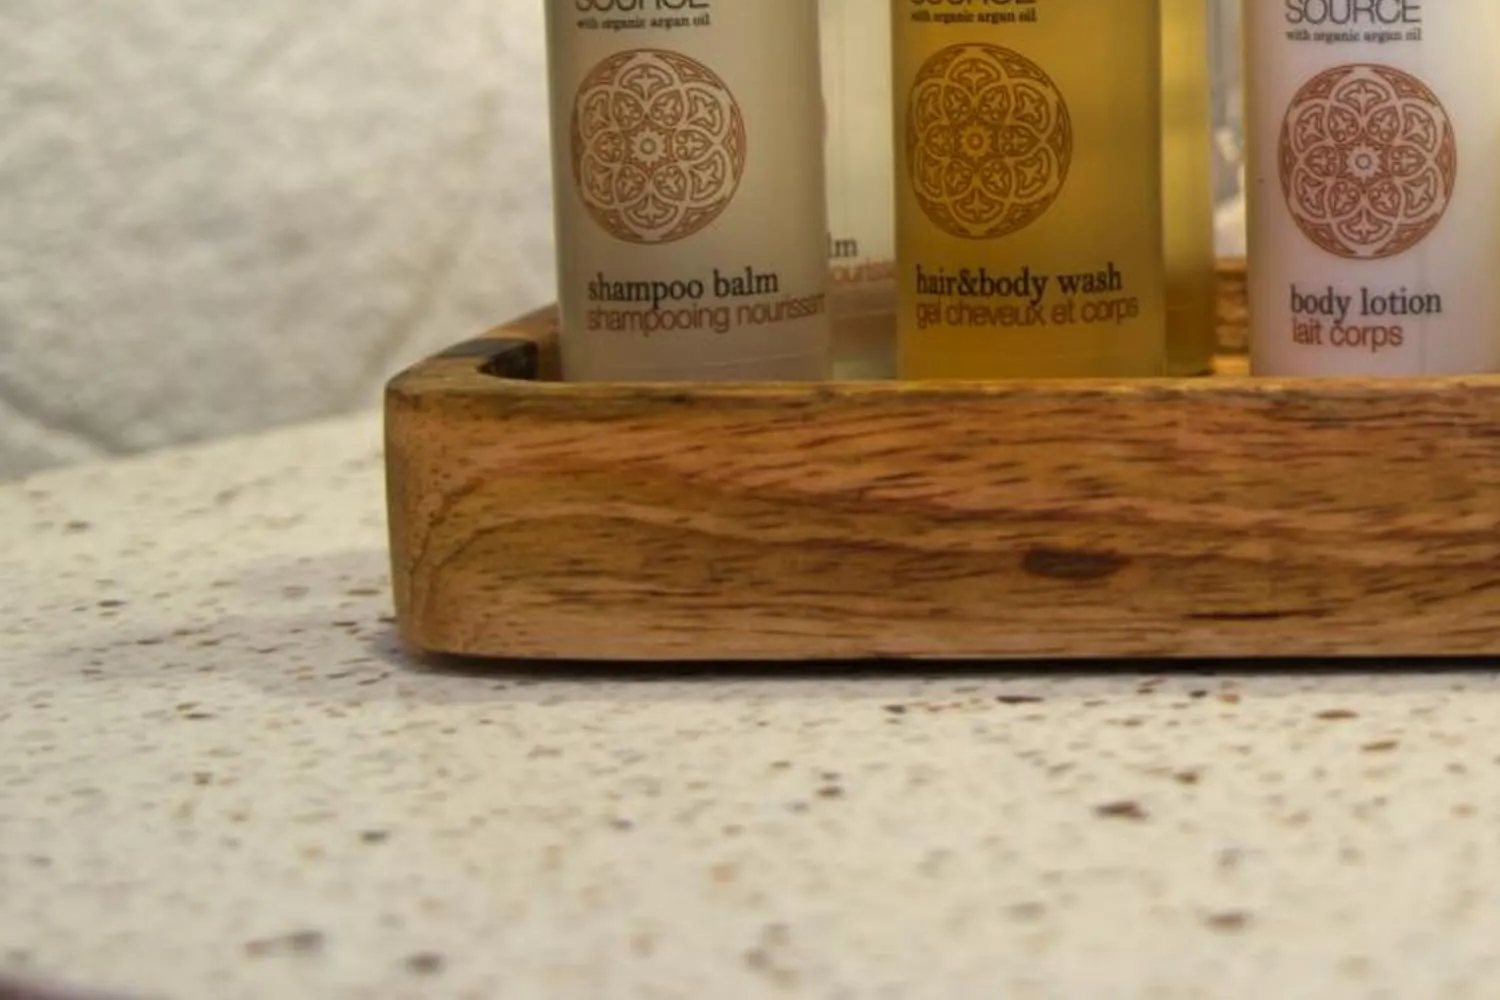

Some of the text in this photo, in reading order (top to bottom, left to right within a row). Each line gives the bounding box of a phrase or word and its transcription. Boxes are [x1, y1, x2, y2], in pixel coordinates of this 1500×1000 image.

[602, 16, 645, 32] organic
[650, 16, 689, 31] argan
[977, 10, 1016, 24] argan
[1019, 8, 1037, 22] oil
[1286, 28, 1311, 41] with
[1313, 28, 1360, 44] organic
[1363, 29, 1402, 44] argan
[588, 266, 779, 309] shampoo balm
[916, 264, 1048, 306] hair&body
[1056, 262, 1122, 294] wash
[588, 303, 729, 337] shampooing
[916, 296, 1139, 329] gel cheveux et corps
[1290, 284, 1442, 324] body lotion
[1292, 318, 1403, 352] lait corps
